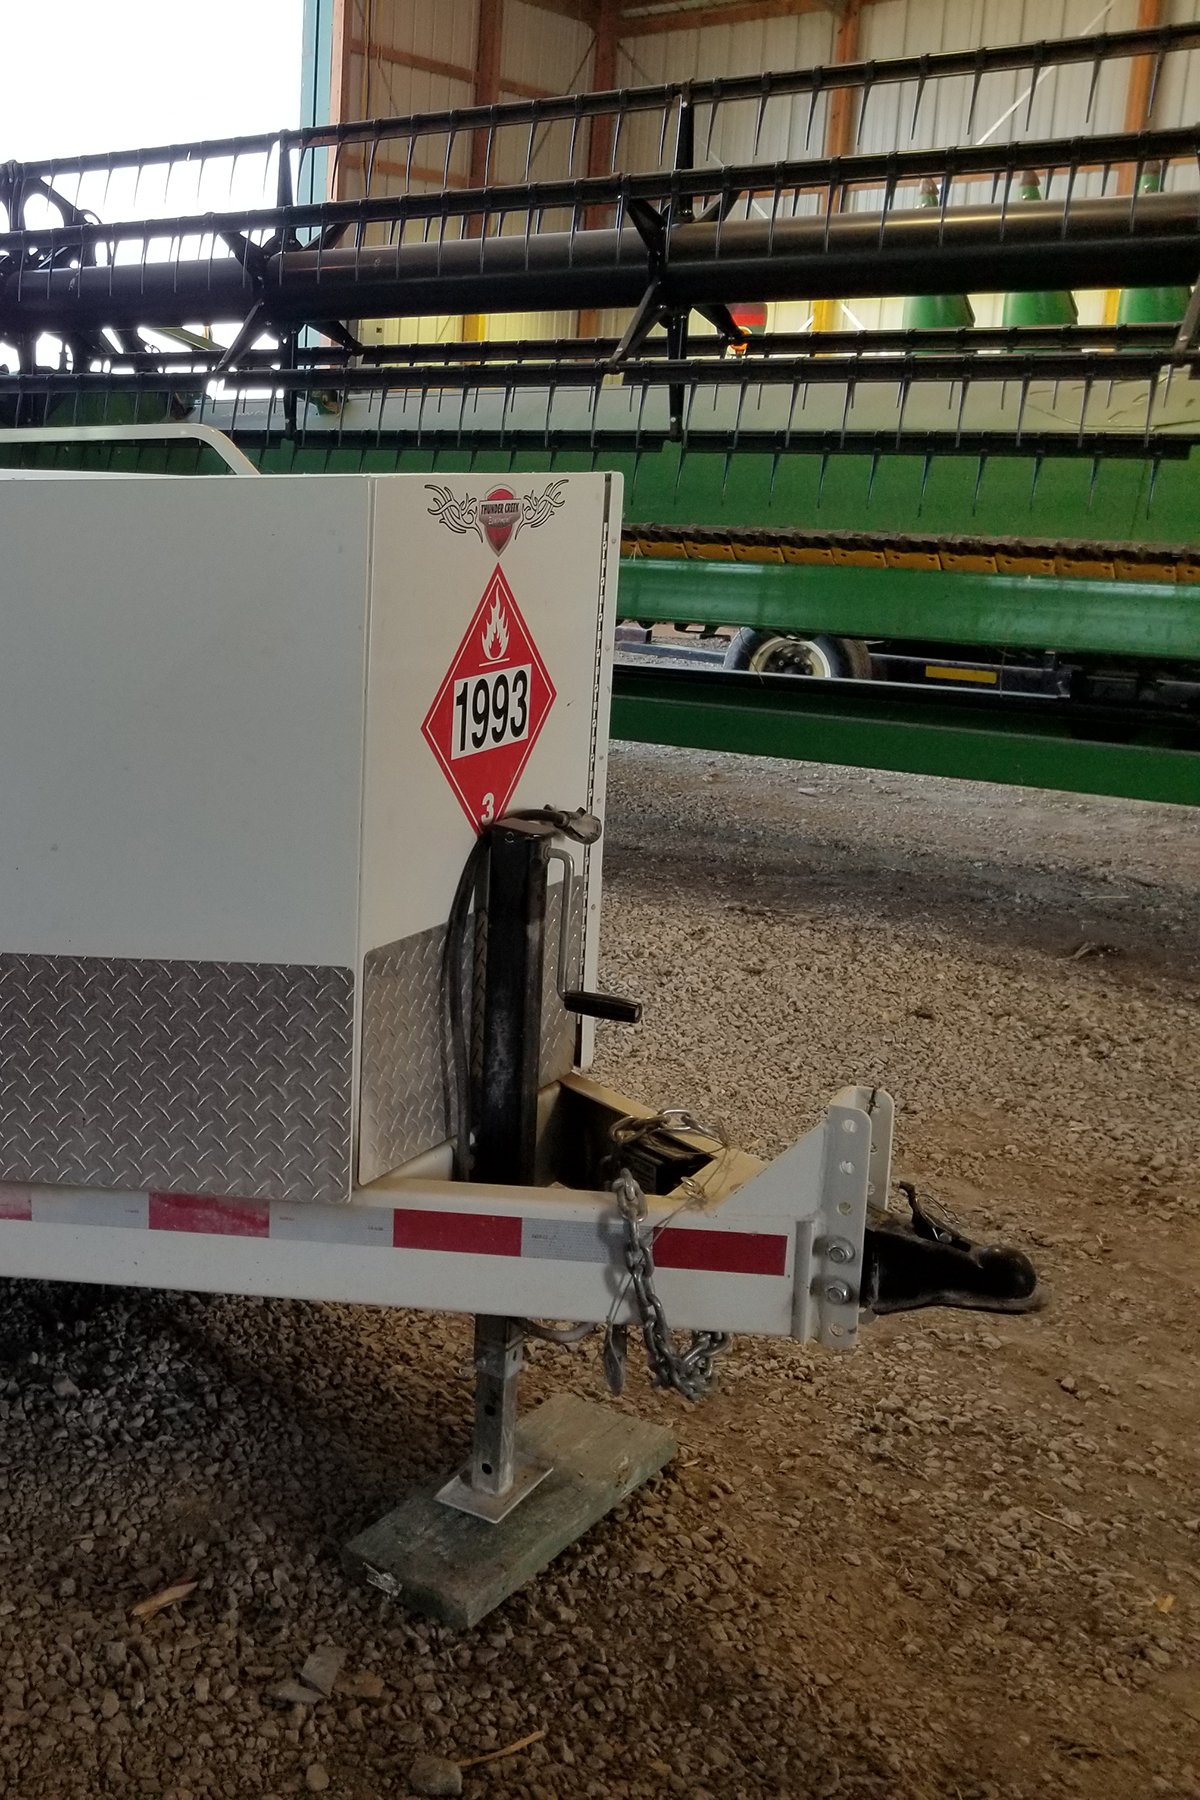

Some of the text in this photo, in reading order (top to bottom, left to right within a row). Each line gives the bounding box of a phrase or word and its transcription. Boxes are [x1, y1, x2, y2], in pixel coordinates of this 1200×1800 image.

[481, 502, 520, 515] THUNDER CREEK
[456, 669, 528, 752] 1993
[480, 792, 495, 826] 3
